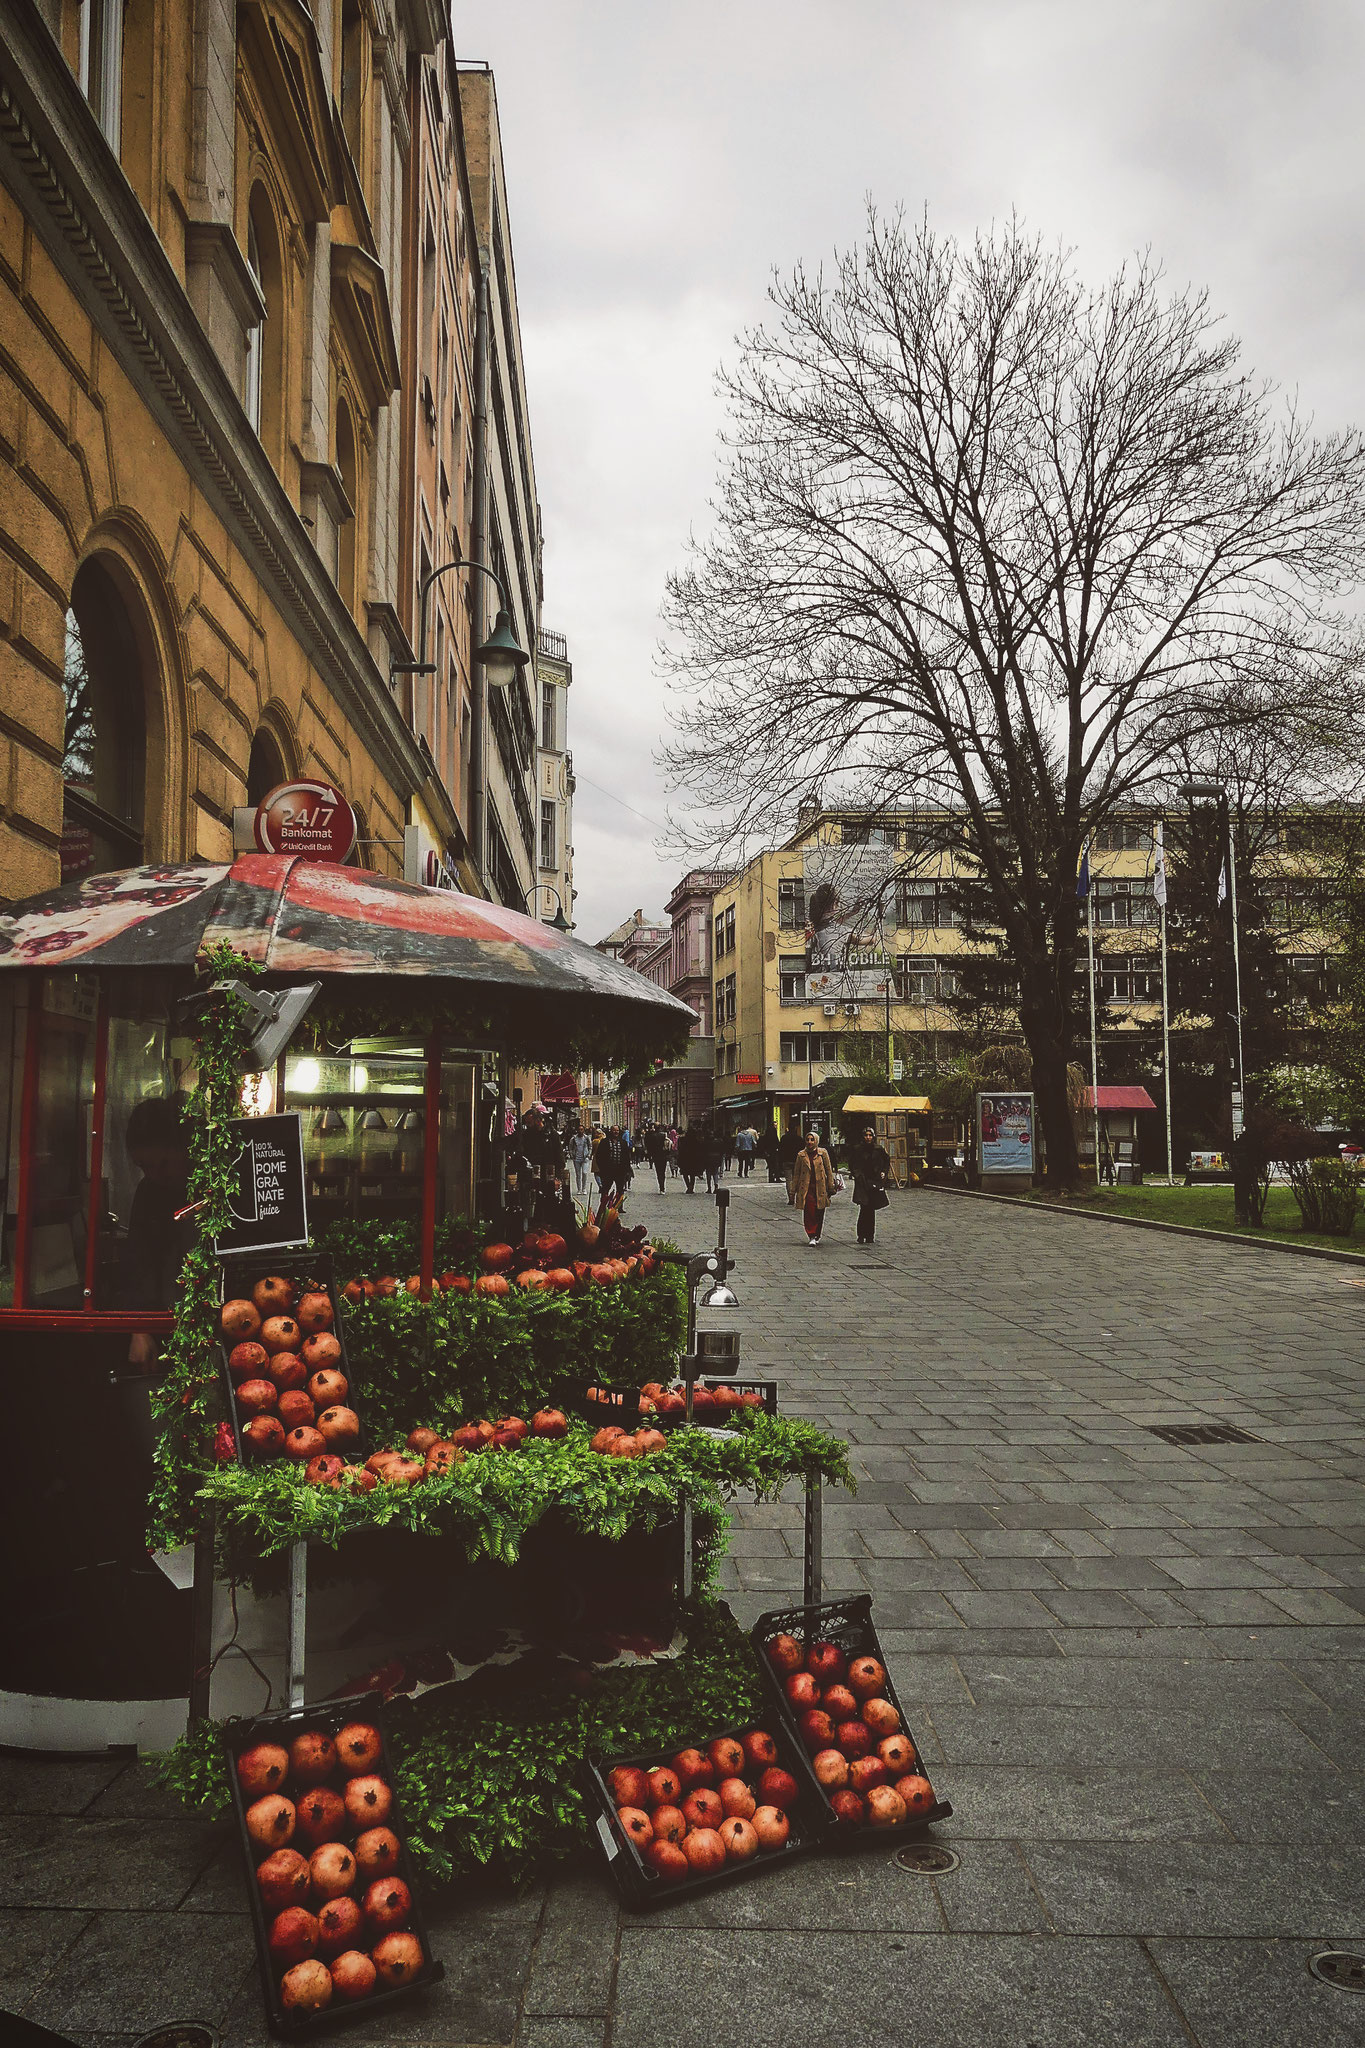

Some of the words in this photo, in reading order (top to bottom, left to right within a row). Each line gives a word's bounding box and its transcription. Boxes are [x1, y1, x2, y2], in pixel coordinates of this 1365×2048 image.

[281, 808, 335, 827] 24/7
[281, 827, 333, 839] Bankomat
[288, 842, 316, 851] UniCredit
[317, 843, 333, 851] Bank
[255, 1149, 286, 1159] NATURAL
[256, 1161, 287, 1175] POME
[256, 1176, 279, 1189] GRA
[257, 1188, 285, 1203] NATE
[259, 1204, 281, 1220] juice
